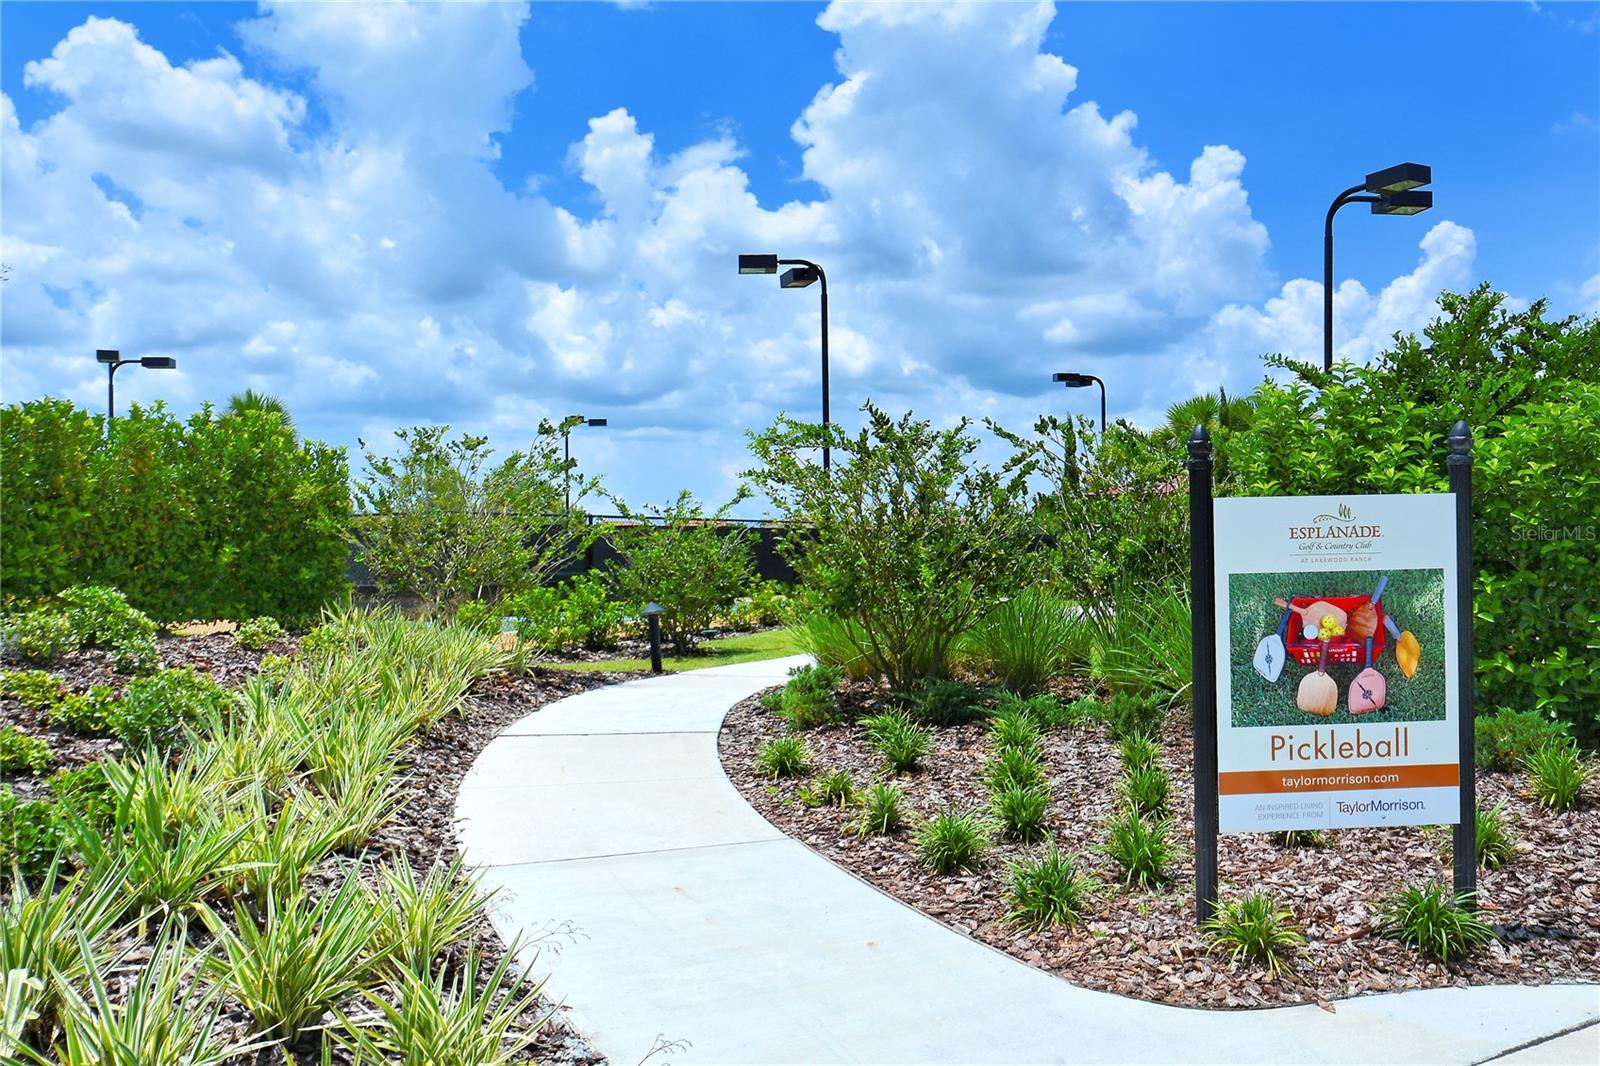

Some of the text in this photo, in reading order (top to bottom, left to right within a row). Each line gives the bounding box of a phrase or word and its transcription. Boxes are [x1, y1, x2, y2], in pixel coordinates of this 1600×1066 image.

[1289, 525, 1381, 539] ESPLANADE
[1298, 540, 1372, 553] Golf & Country Club
[1271, 727, 1408, 761] Pickleball
[1281, 773, 1399, 788] taylormorrison.com
[1267, 803, 1299, 811] INSPIRED
[1301, 802, 1323, 810] LIVING
[1257, 811, 1323, 820] EXPERIENCE FROM
